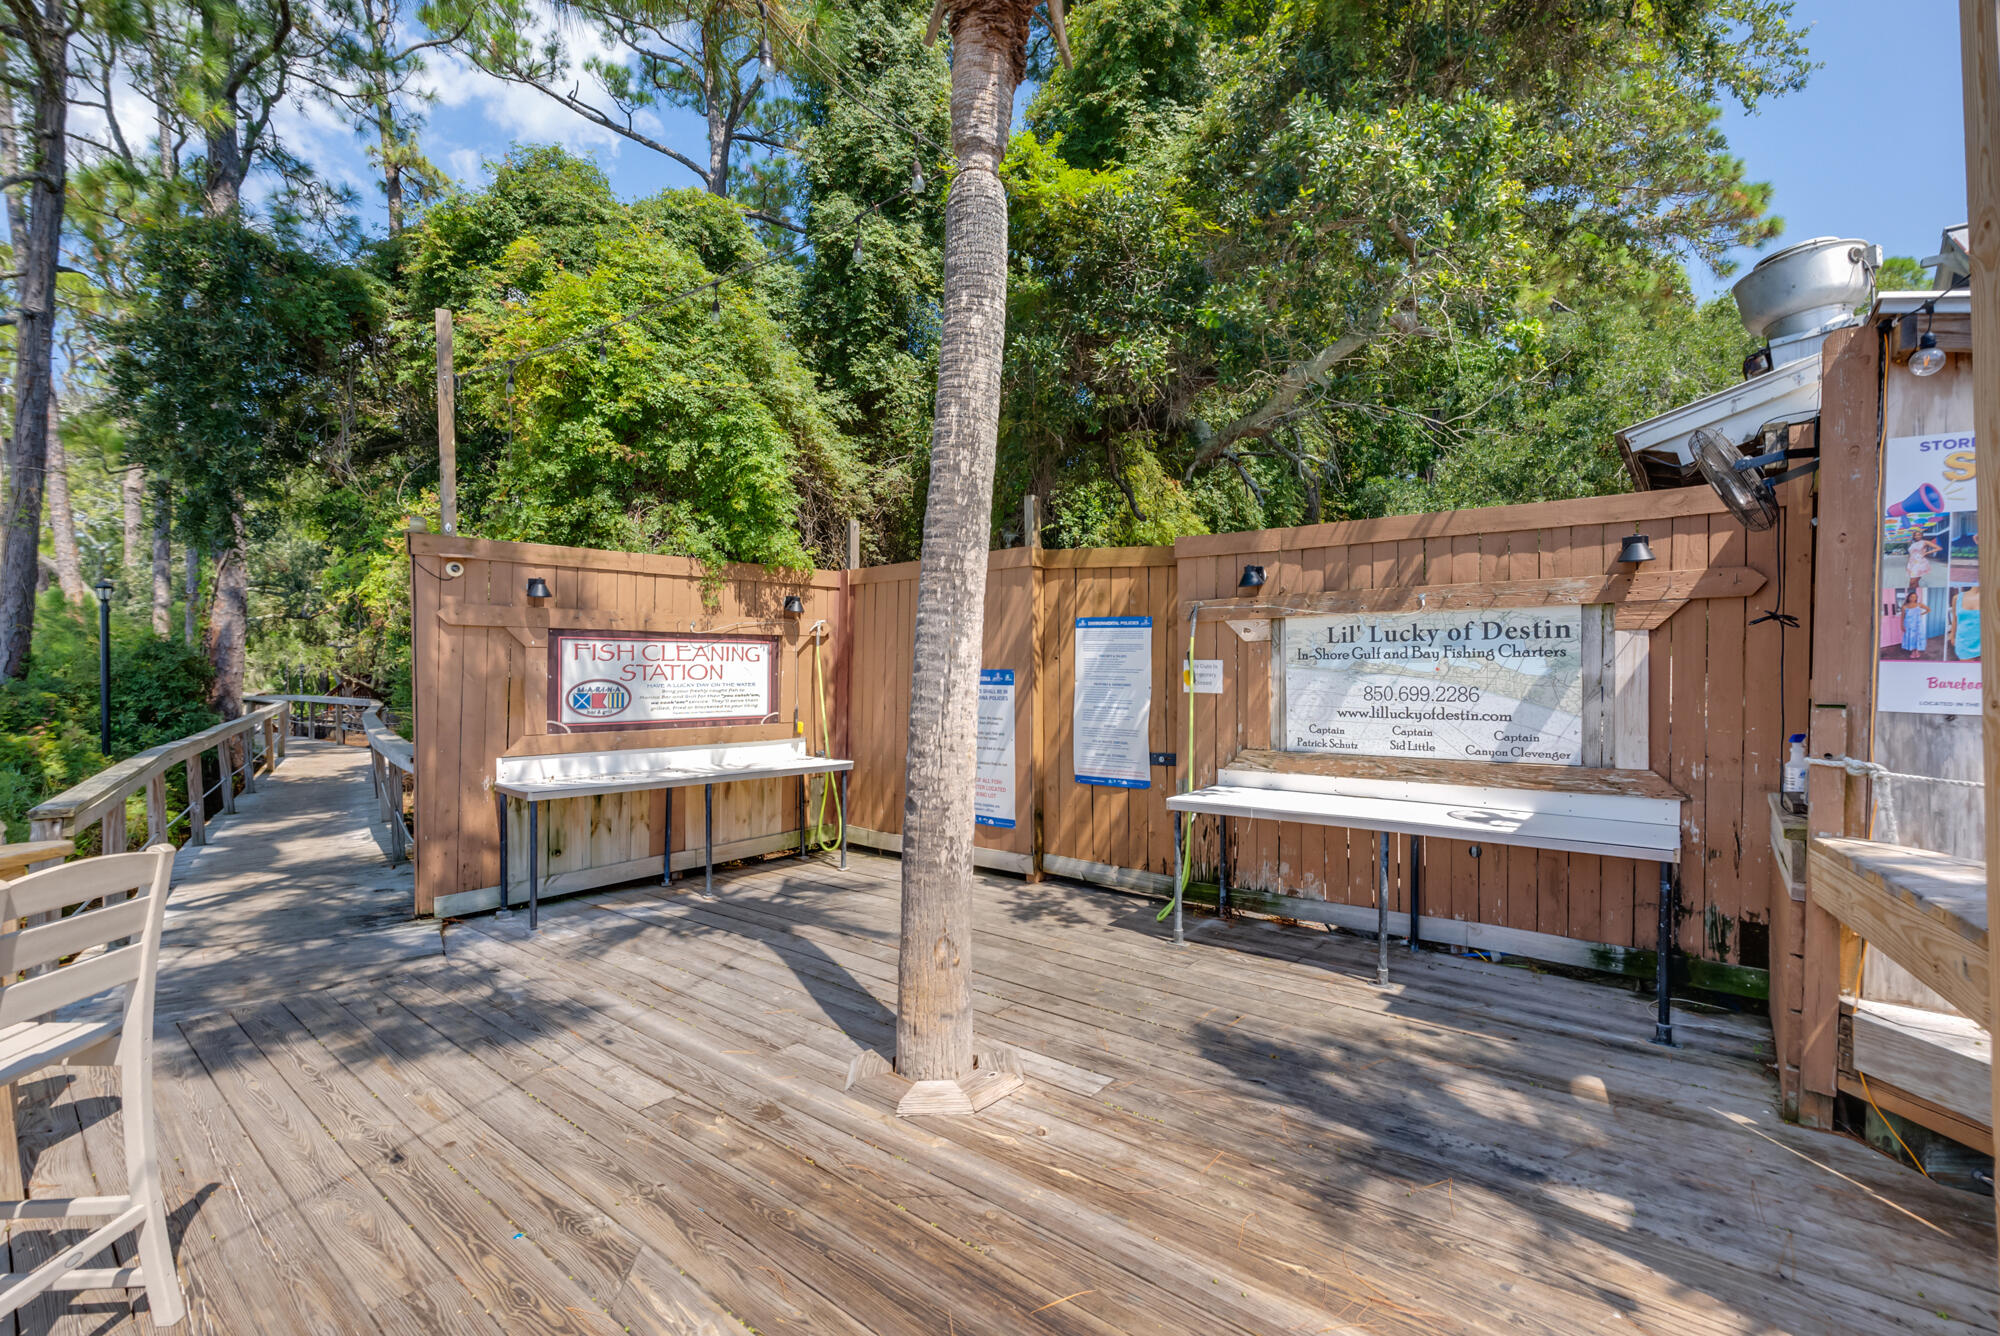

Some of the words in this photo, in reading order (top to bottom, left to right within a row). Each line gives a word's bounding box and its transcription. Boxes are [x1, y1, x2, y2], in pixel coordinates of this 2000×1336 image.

[1327, 625, 1360, 644] Lil'
[1368, 623, 1440, 647] Lucky
[1447, 621, 1475, 641] of
[1481, 620, 1571, 640] Destin
[574, 643, 635, 661] FISH
[641, 644, 760, 662] CLEANING
[1297, 647, 1350, 660] In-Shore
[1351, 646, 1382, 660] Gulf
[1383, 646, 1408, 659] and
[1411, 645, 1440, 662] Bay
[1443, 645, 1495, 661] Fishing
[1498, 643, 1566, 658] Charters
[619, 664, 723, 681] STATION
[1363, 686, 1480, 702] 850.699.2286
[1337, 706, 1512, 722] www.lilluckyofdestin.com
[1308, 724, 1345, 736] Captain
[1392, 725, 1433, 738] Captain
[1494, 730, 1540, 743] Captain
[1297, 737, 1329, 748] Patrick
[1329, 738, 1358, 750] Schutz
[1390, 740, 1406, 751] Sid
[1408, 740, 1436, 752] Little
[1465, 744, 1508, 759] Canyon
[1510, 746, 1572, 761] Clevenger
